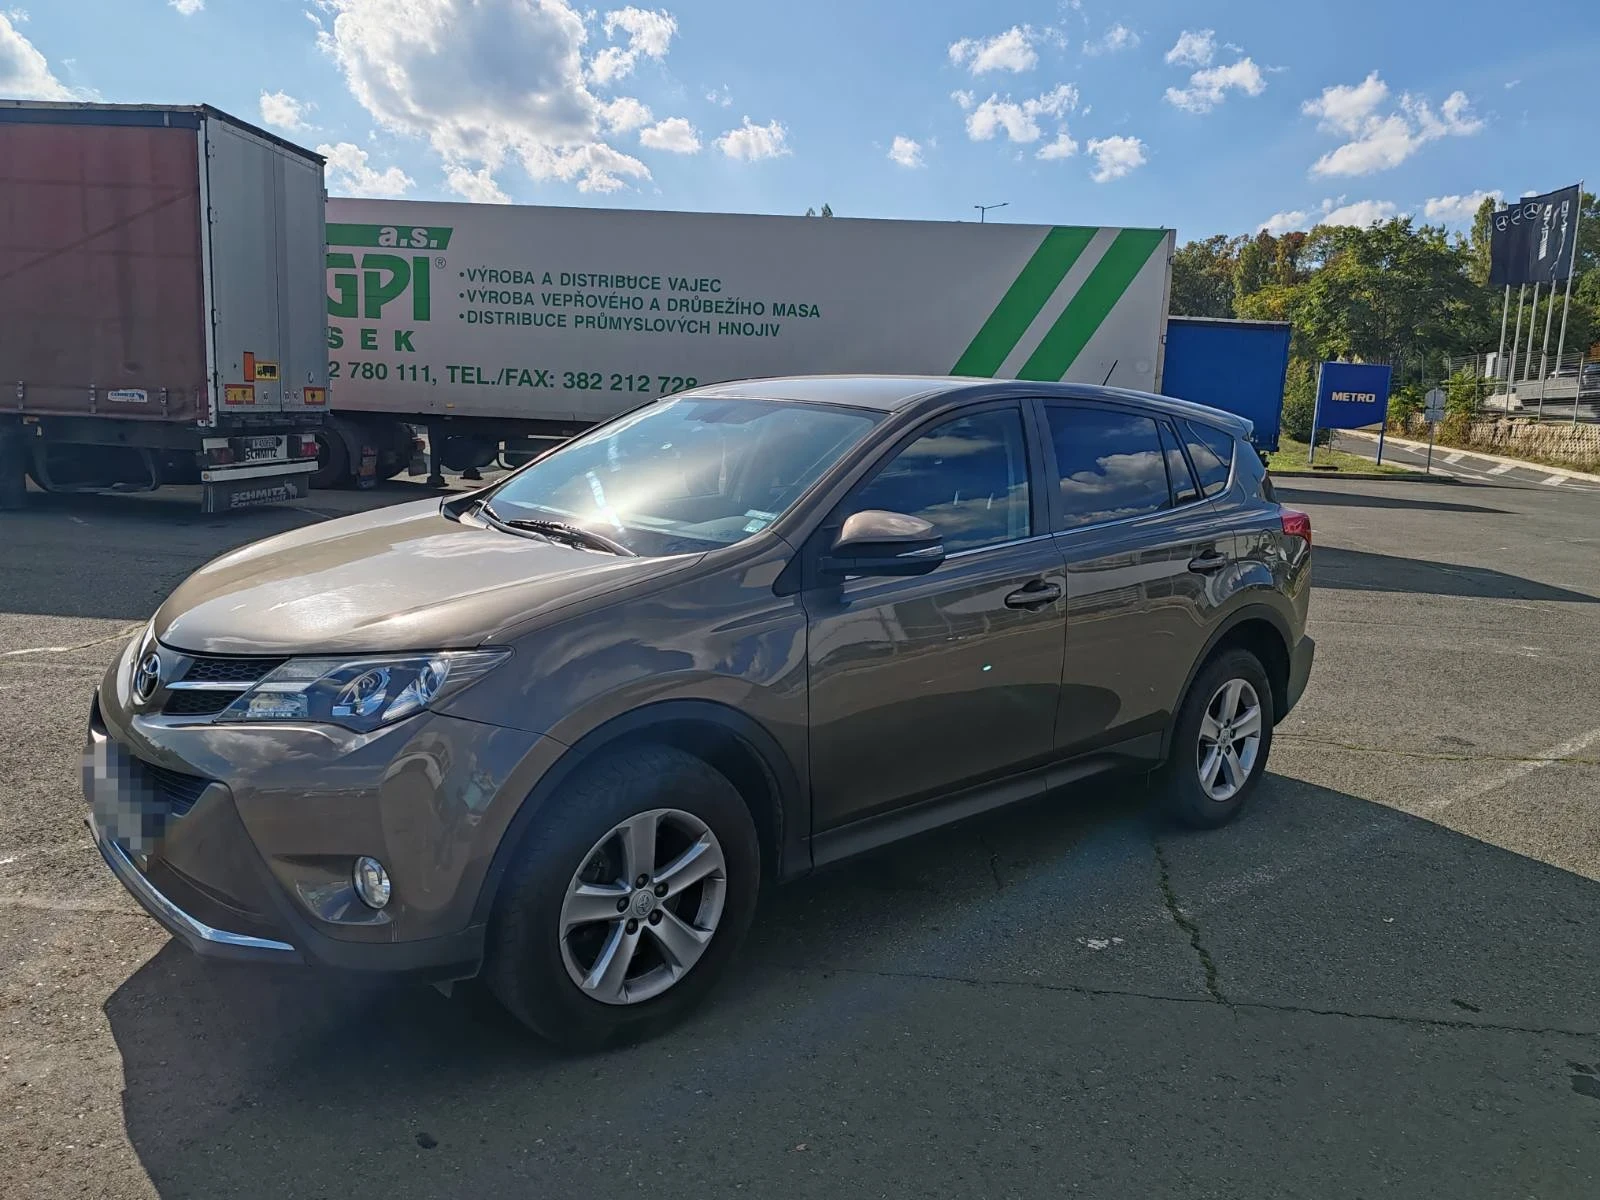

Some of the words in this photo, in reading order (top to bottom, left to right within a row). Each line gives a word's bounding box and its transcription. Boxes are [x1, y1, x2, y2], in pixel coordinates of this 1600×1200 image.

[378, 226, 438, 248] a.s.
[467, 264, 535, 285] VÝROBA
[541, 271, 553, 286] A
[560, 272, 661, 290] DISTRIBUCE
[668, 277, 722, 293] VAJEC
[467, 285, 535, 306] VÝROBA
[541, 290, 644, 311] VEPŘOVÉHO
[649, 297, 661, 312] A
[667, 295, 765, 316] DRŮBEŽÍHO
[772, 302, 821, 318] MASA
[467, 310, 567, 328] DISTRIBUCE
[574, 312, 711, 335] PRŮMYSLOVÝCH
[718, 321, 781, 337] HNOJIV
[347, 361, 388, 380] 780
[396, 364, 437, 386] 111,
[446, 365, 555, 388] TEL./FAX:
[563, 371, 602, 390] 382
[610, 373, 650, 392] 212
[1331, 391, 1376, 403] METRO
